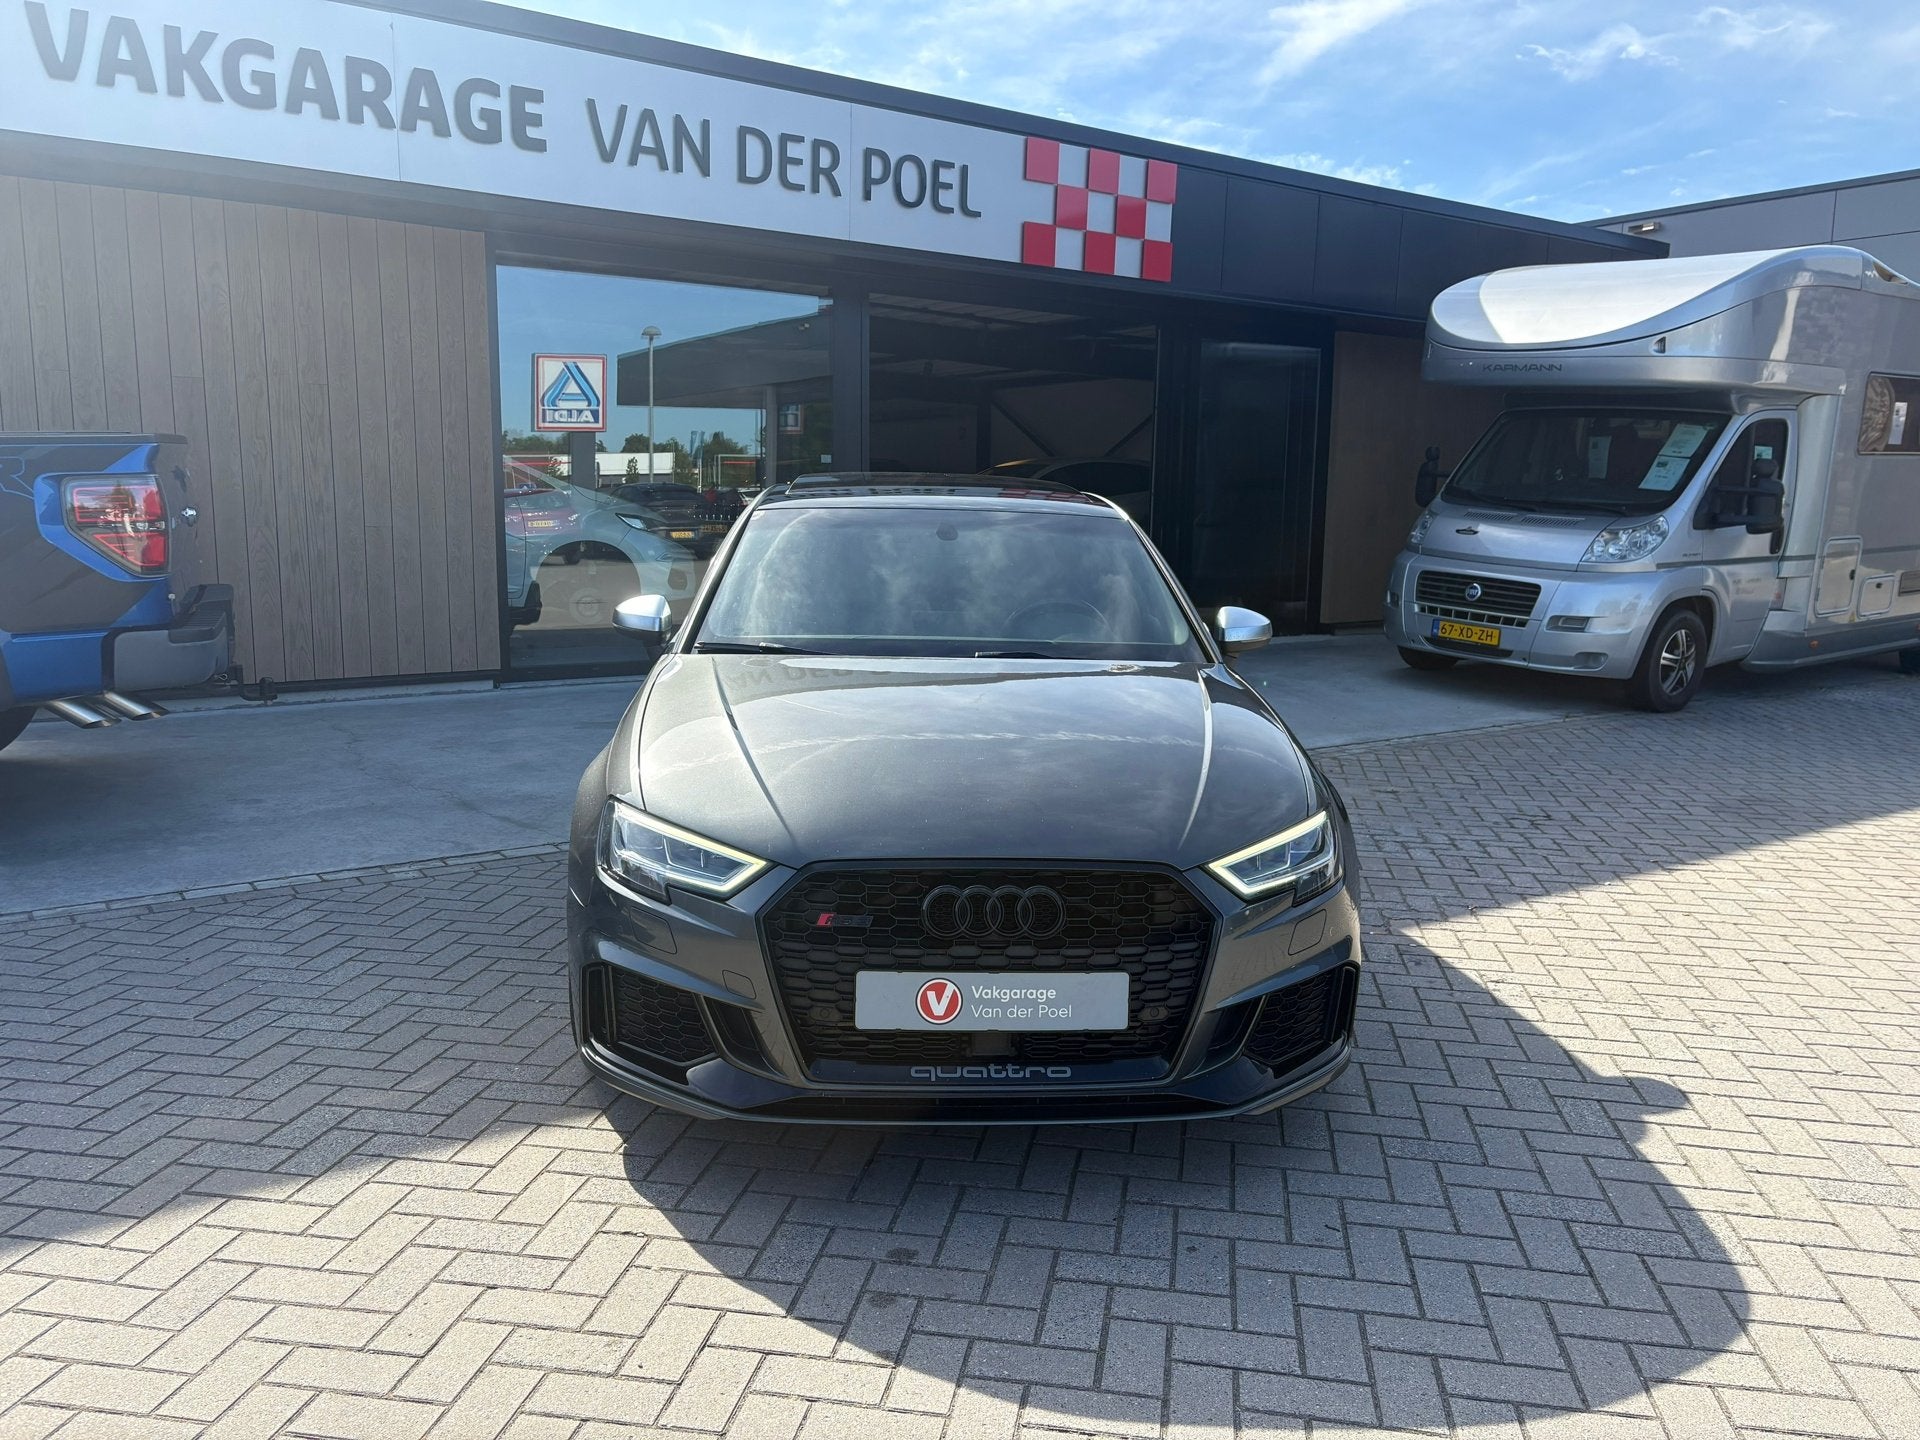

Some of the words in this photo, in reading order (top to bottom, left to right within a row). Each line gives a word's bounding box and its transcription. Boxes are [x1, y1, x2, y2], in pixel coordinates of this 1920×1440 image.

[24, 0, 547, 152] VAKGARAGE
[586, 97, 710, 179] VAN
[737, 125, 841, 198] DER
[863, 147, 982, 219] POEL
[1482, 363, 1562, 372] KARMANN
[1440, 623, 1494, 642] 67-XD-ZH
[971, 985, 1057, 1002] Vakgarage
[971, 1004, 1002, 1018] Van
[1006, 1004, 1034, 1018] der
[1038, 1004, 1072, 1018] Poel
[910, 1063, 1072, 1081] quattro
